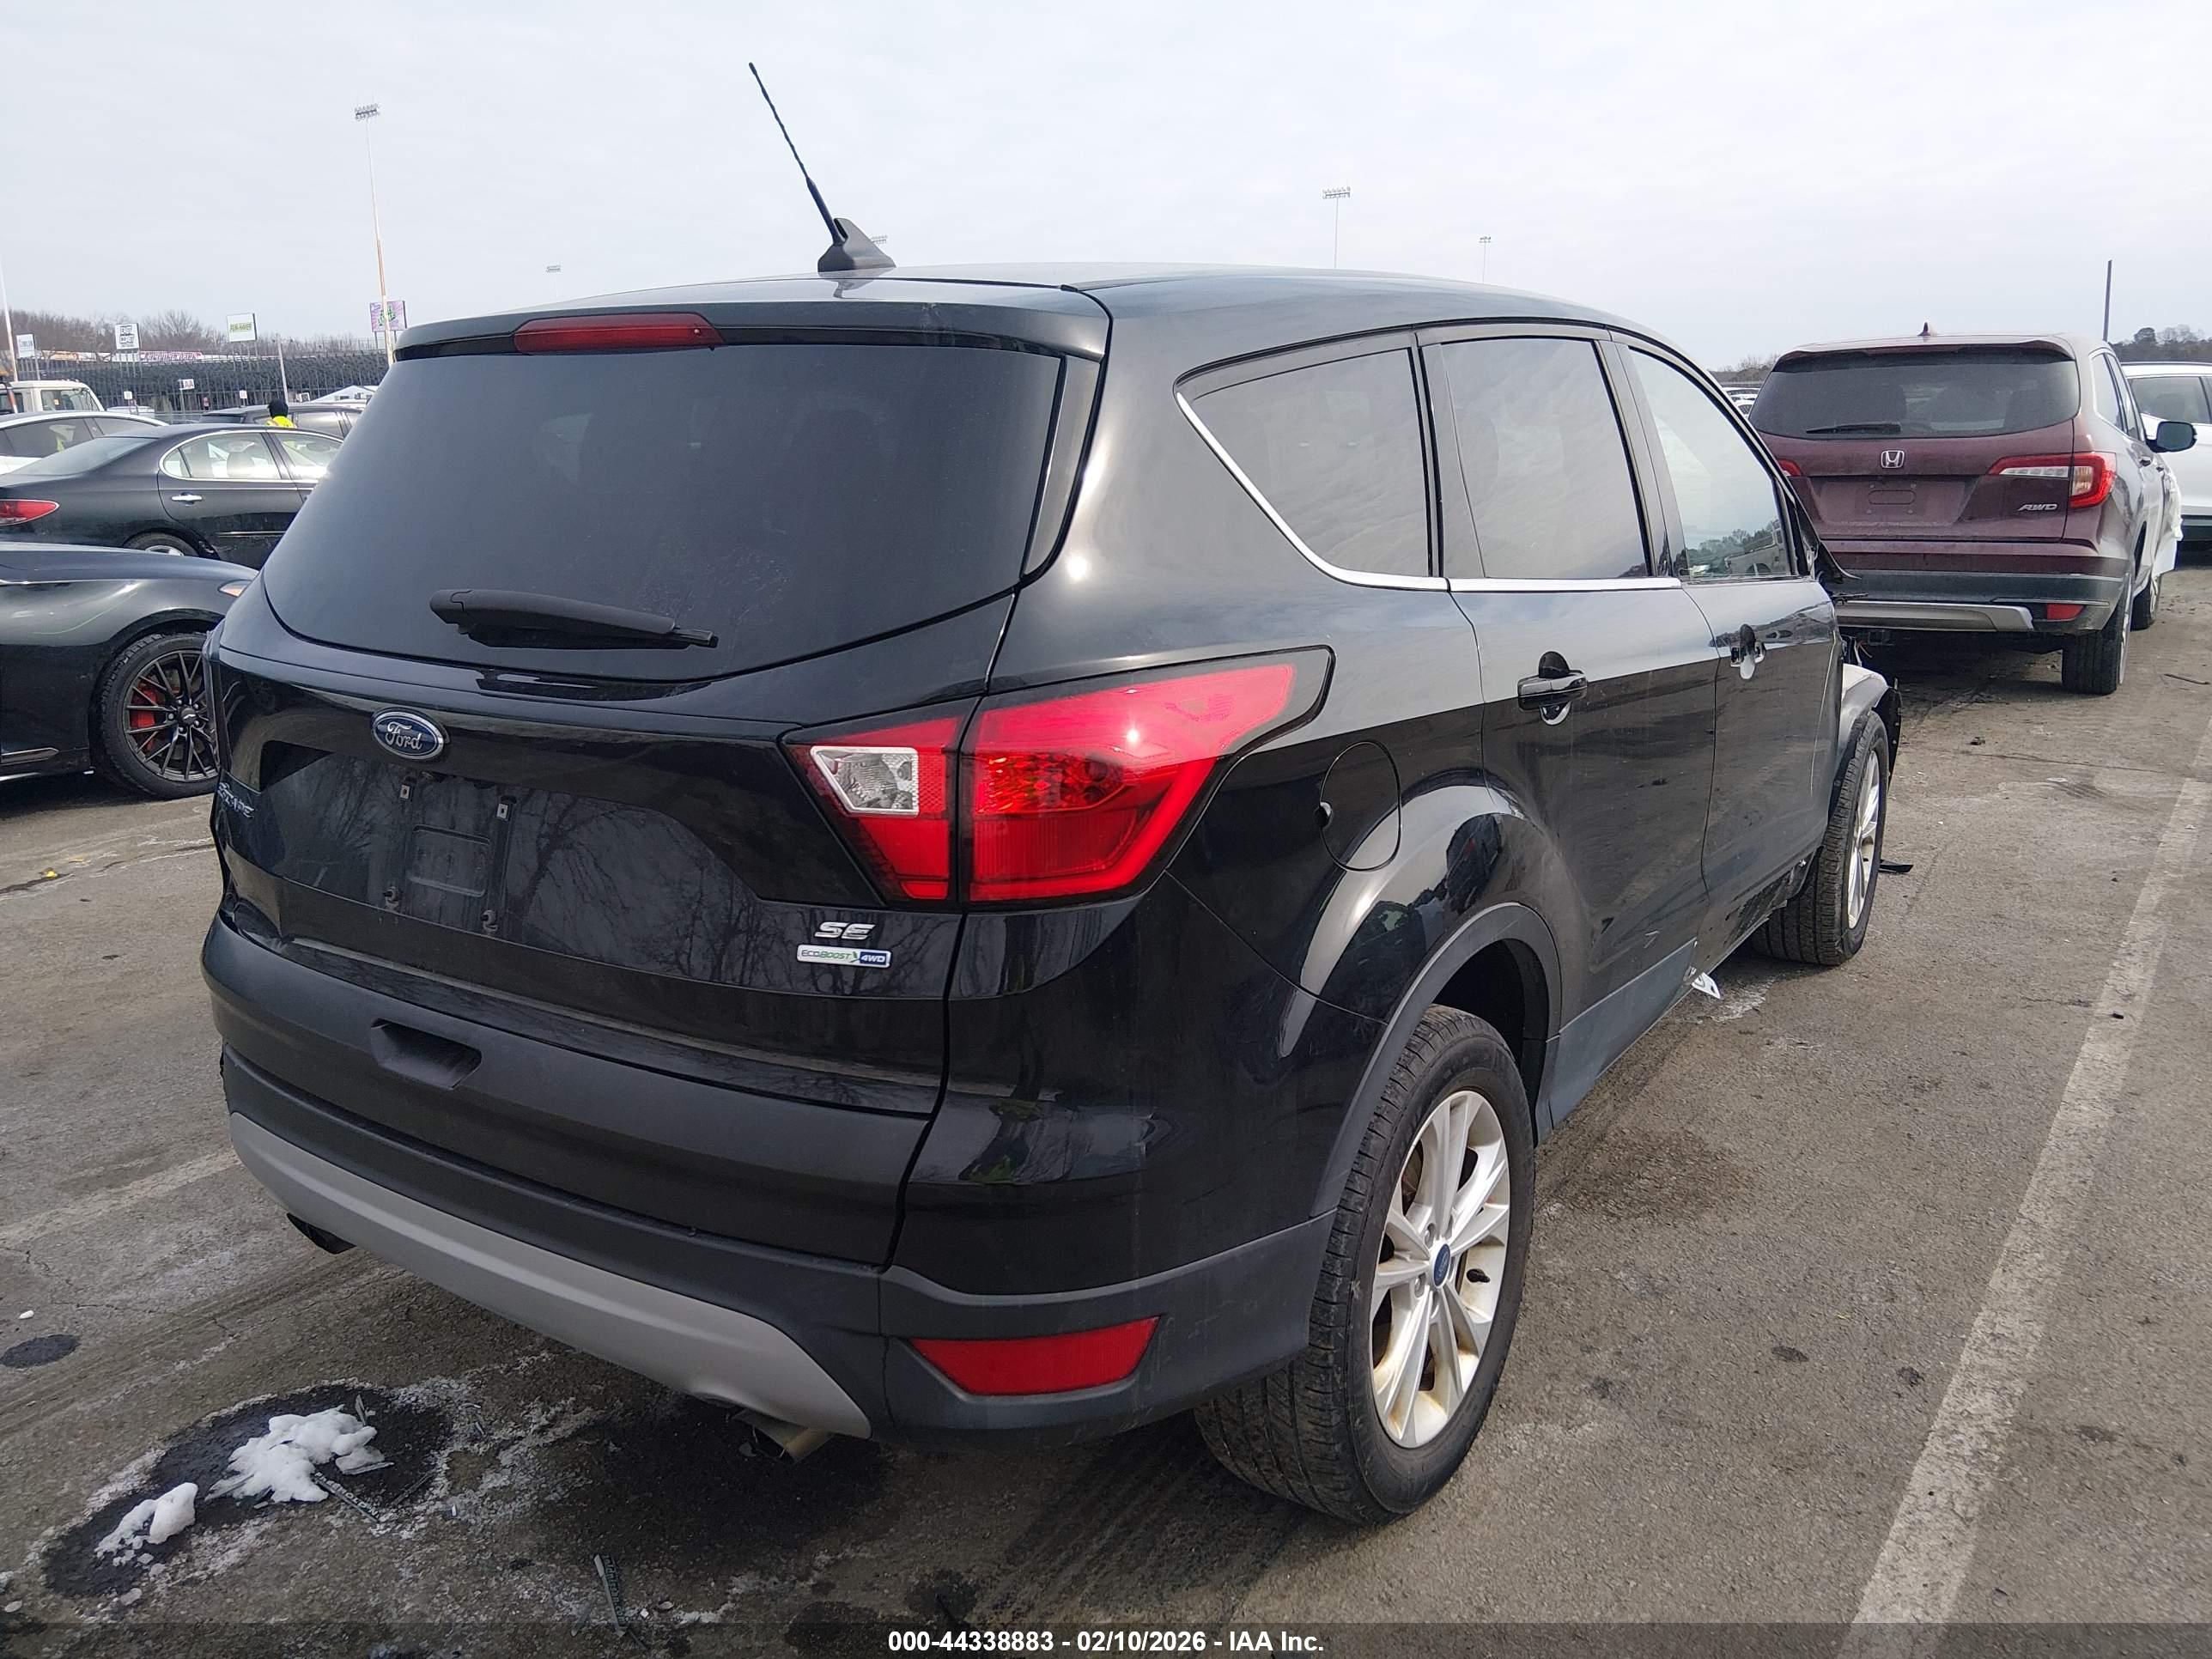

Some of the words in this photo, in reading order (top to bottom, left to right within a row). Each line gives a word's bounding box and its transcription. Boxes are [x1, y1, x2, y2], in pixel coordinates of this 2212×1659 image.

[385, 721, 422, 750] Ford
[814, 921, 876, 940] SE
[861, 954, 885, 963] 4WD
